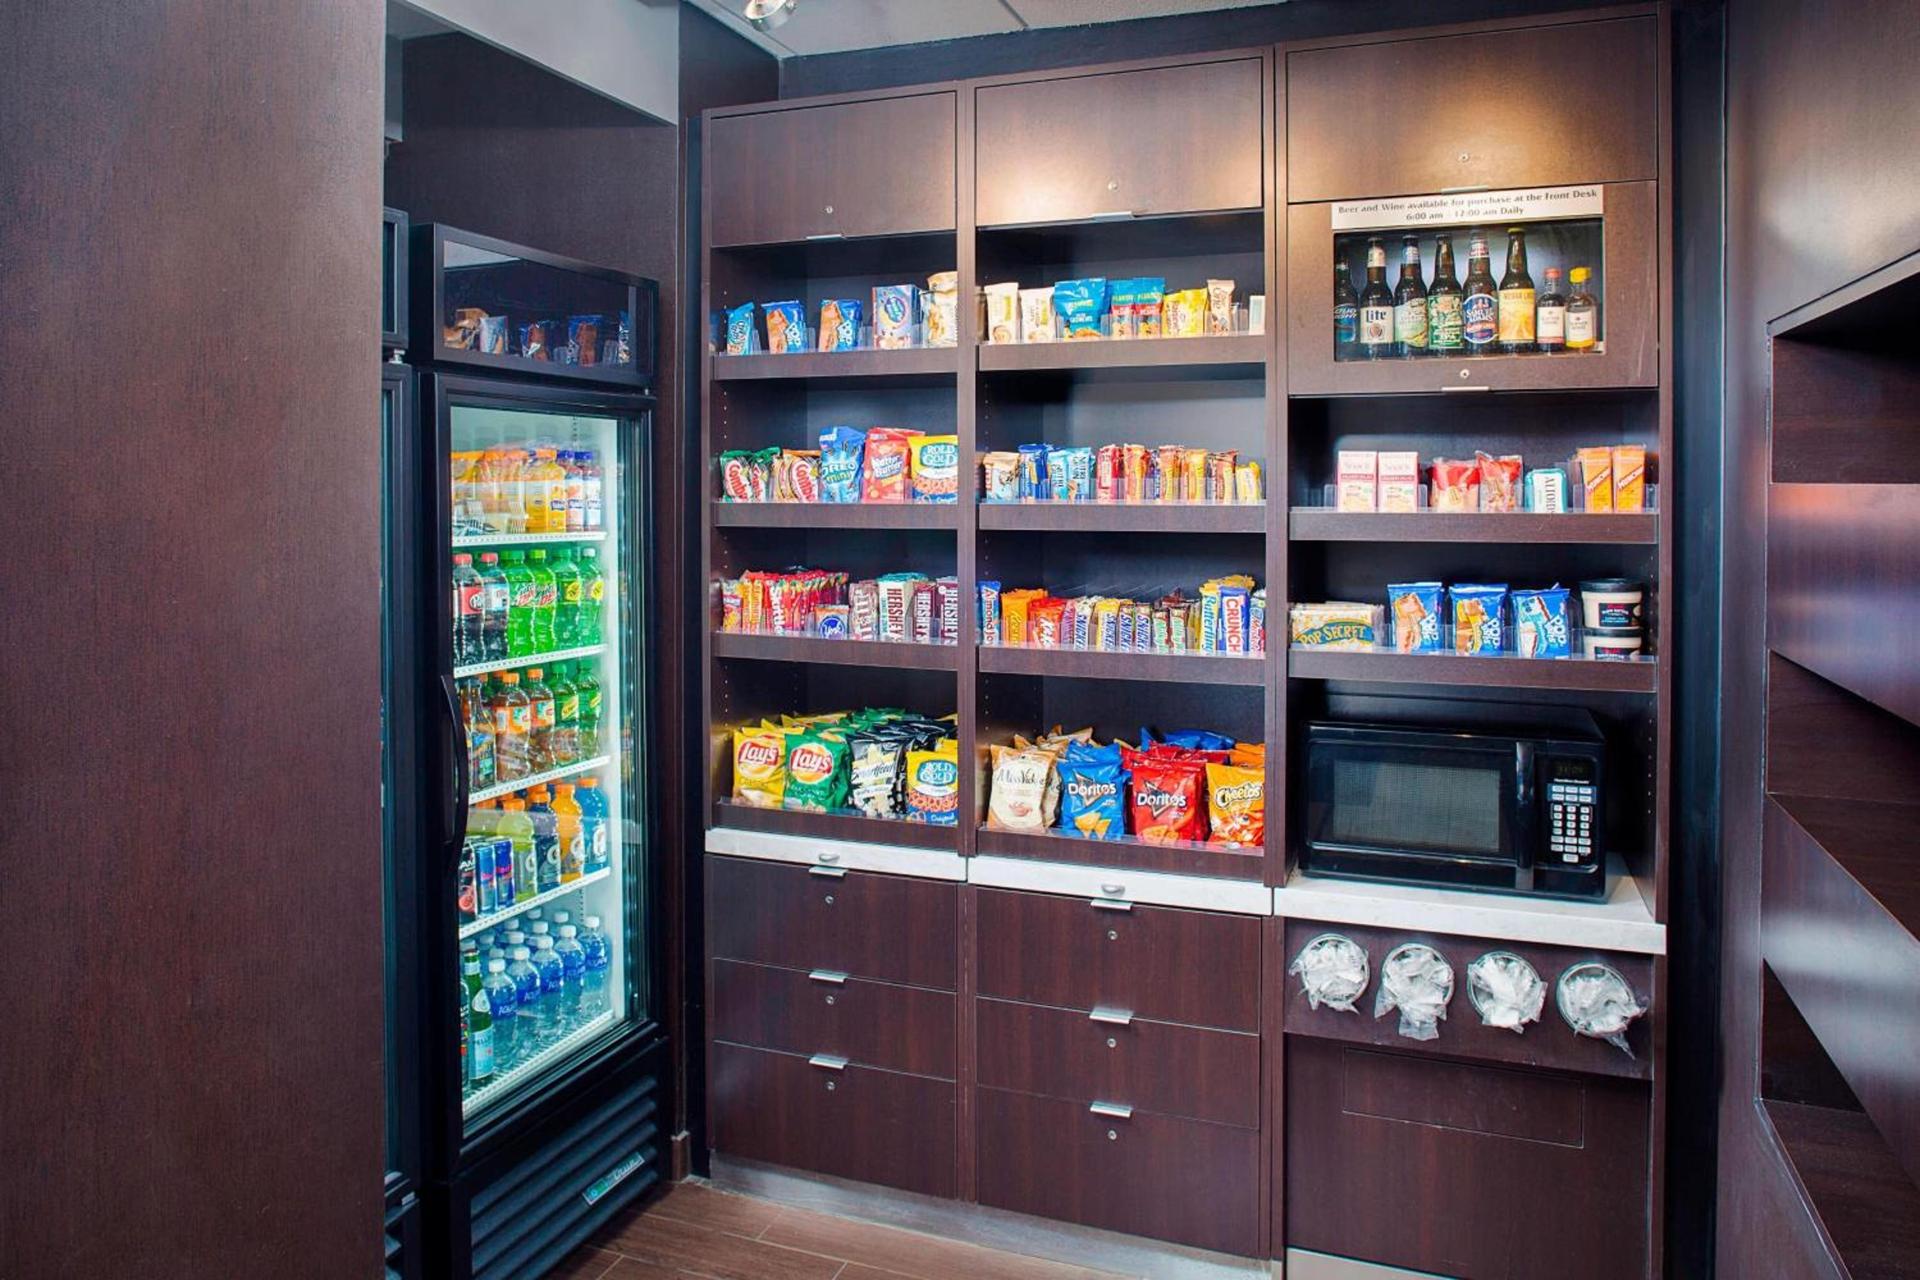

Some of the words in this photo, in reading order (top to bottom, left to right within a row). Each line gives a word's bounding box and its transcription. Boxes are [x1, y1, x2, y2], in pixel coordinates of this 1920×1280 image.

[1338, 206, 1358, 214] Beer
[1361, 204, 1378, 212] and
[1382, 203, 1405, 211] Wine
[1407, 200, 1450, 209] available
[1452, 198, 1464, 206] for
[1467, 196, 1511, 208] purchase
[1526, 193, 1542, 201] the
[1572, 189, 1597, 198] Desk
[1500, 206, 1524, 216] Daily
[1366, 310, 1387, 324] Lite
[926, 444, 956, 455] ROLD
[923, 454, 957, 467] GOLD
[822, 463, 856, 479] OREO
[984, 588, 997, 630] Almond
[1225, 598, 1241, 652] CRUNCH
[1322, 624, 1366, 641] SECRET
[1298, 630, 1322, 645] POP
[919, 771, 954, 784] GOLD
[1068, 782, 1117, 797] Doritos
[1216, 783, 1263, 808] Cheetos
[1136, 793, 1187, 807] Doritos
